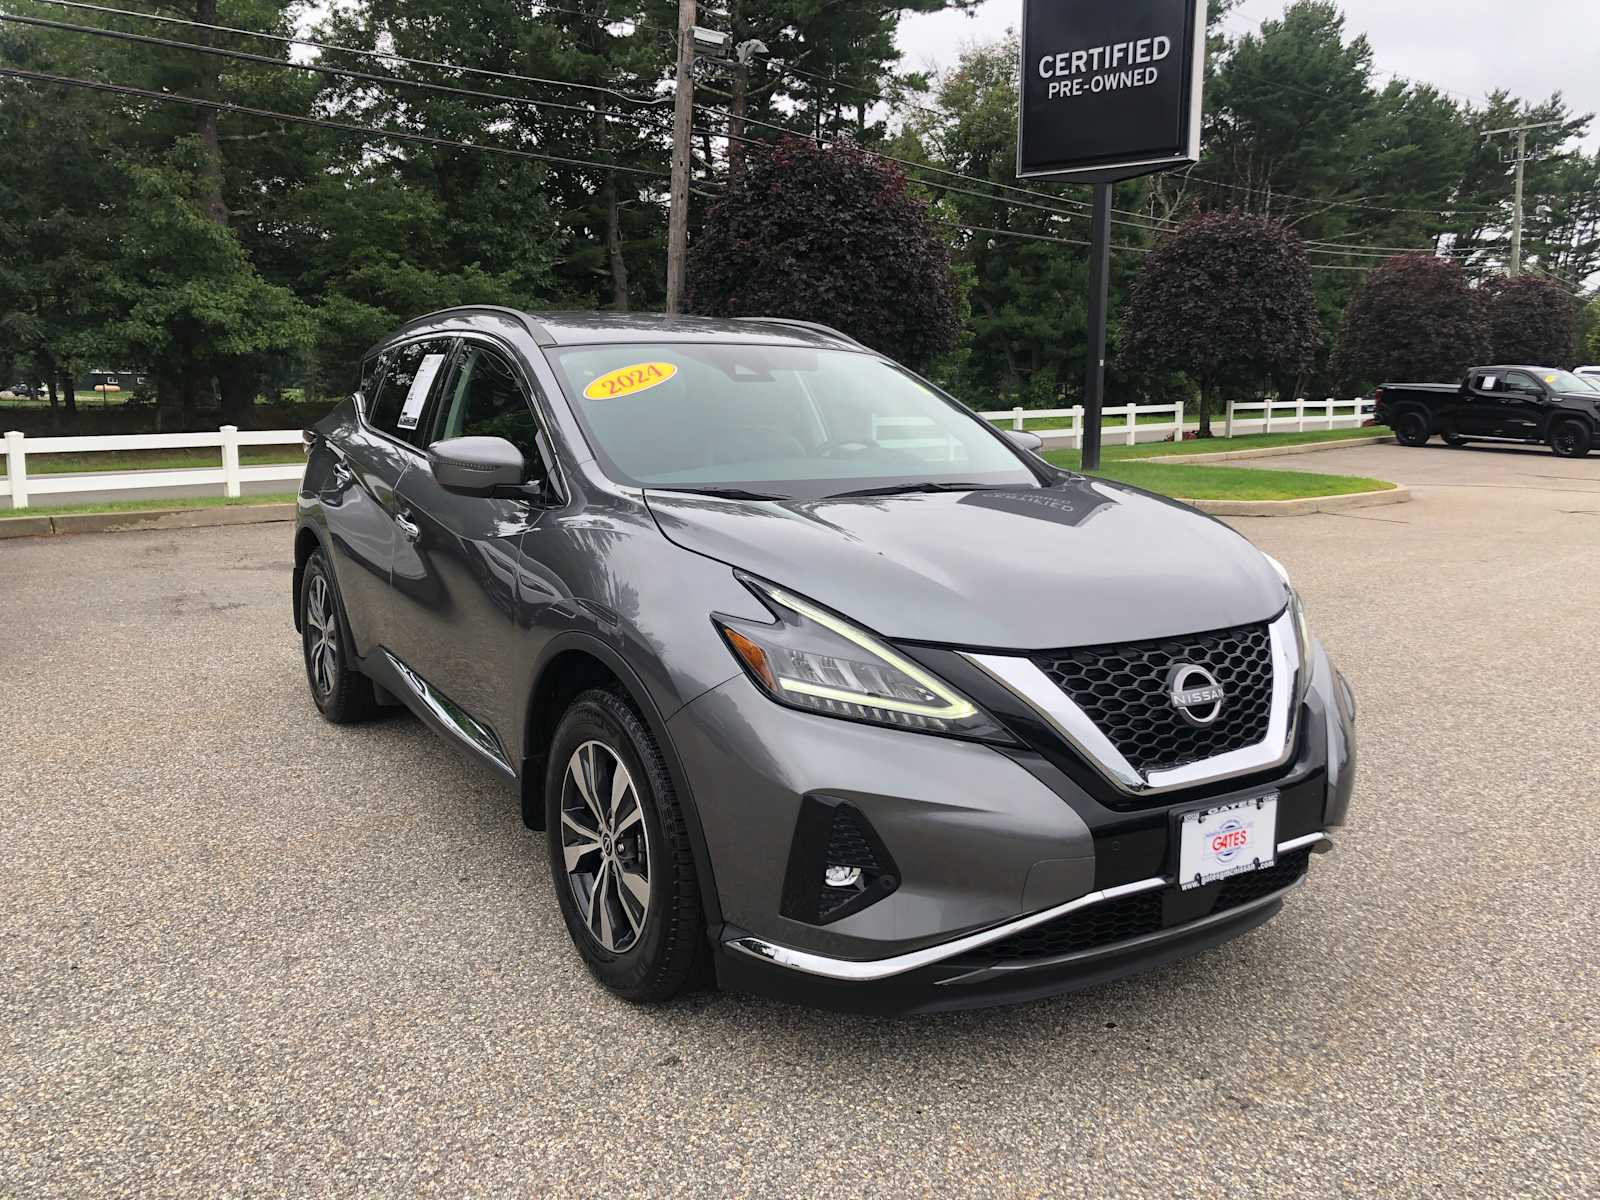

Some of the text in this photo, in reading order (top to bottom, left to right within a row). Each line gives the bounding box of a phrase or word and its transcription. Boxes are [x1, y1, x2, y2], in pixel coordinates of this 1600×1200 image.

[1039, 36, 1171, 78] CERTIFIED
[1048, 67, 1158, 99] PRE-OWNED
[601, 364, 662, 395] 2024
[1173, 688, 1224, 705] NISSAN
[1212, 830, 1247, 851] GATES
